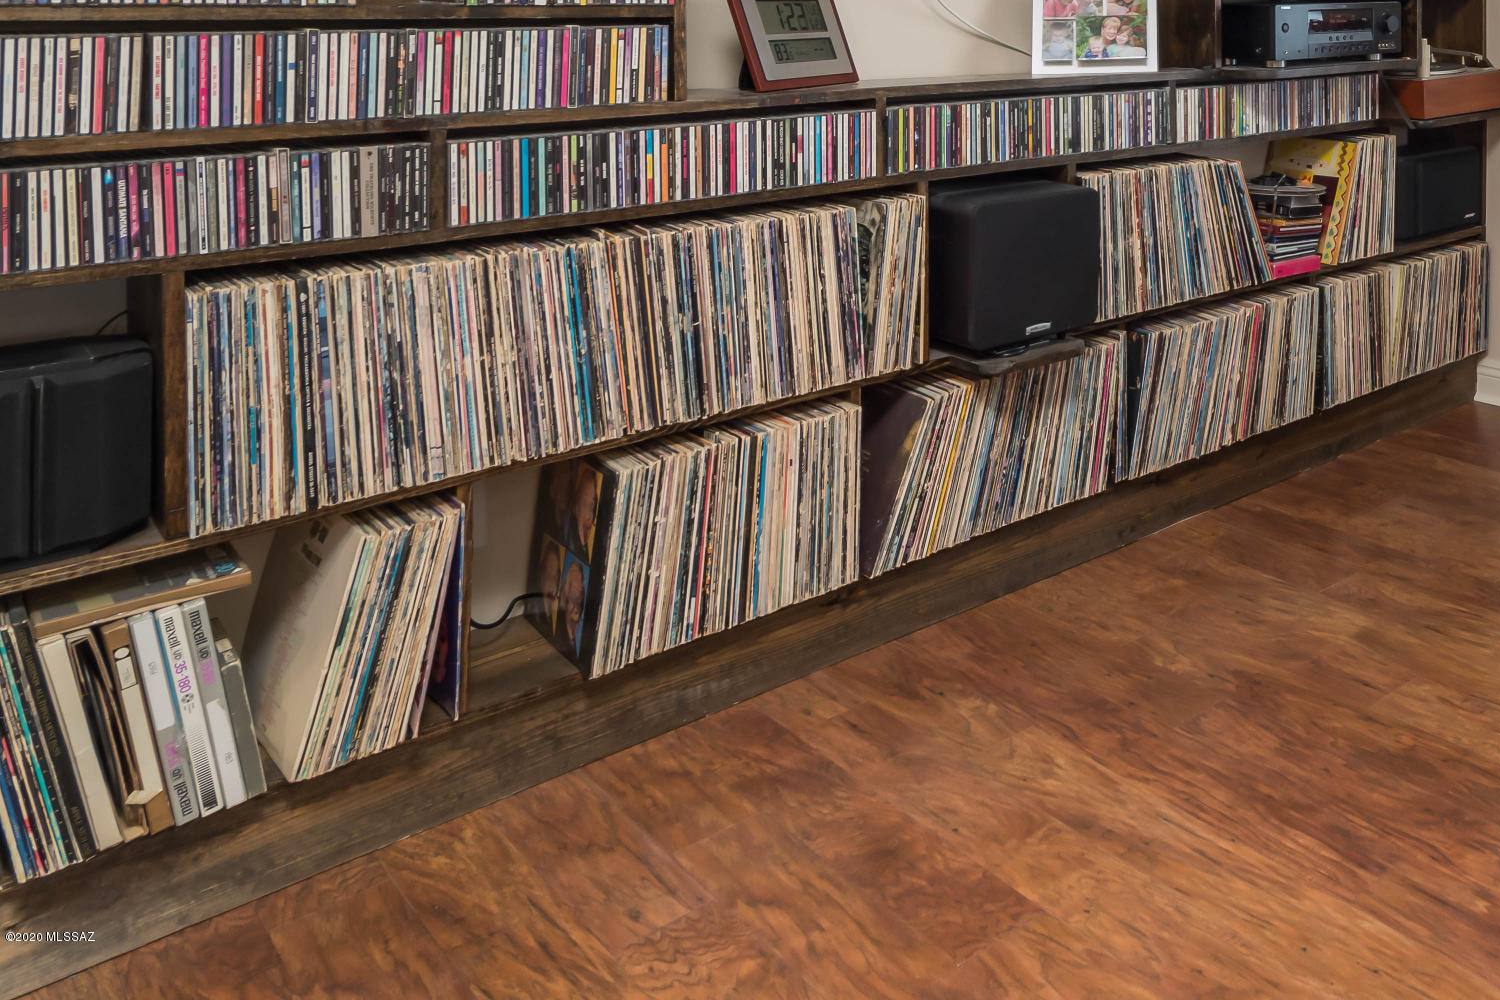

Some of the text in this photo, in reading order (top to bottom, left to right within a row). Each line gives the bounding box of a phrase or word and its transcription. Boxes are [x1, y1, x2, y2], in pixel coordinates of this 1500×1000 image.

[189, 610, 208, 647] maxell
[163, 616, 182, 651] maxell
[173, 659, 192, 694] 35-180
[172, 780, 193, 817] maxell
